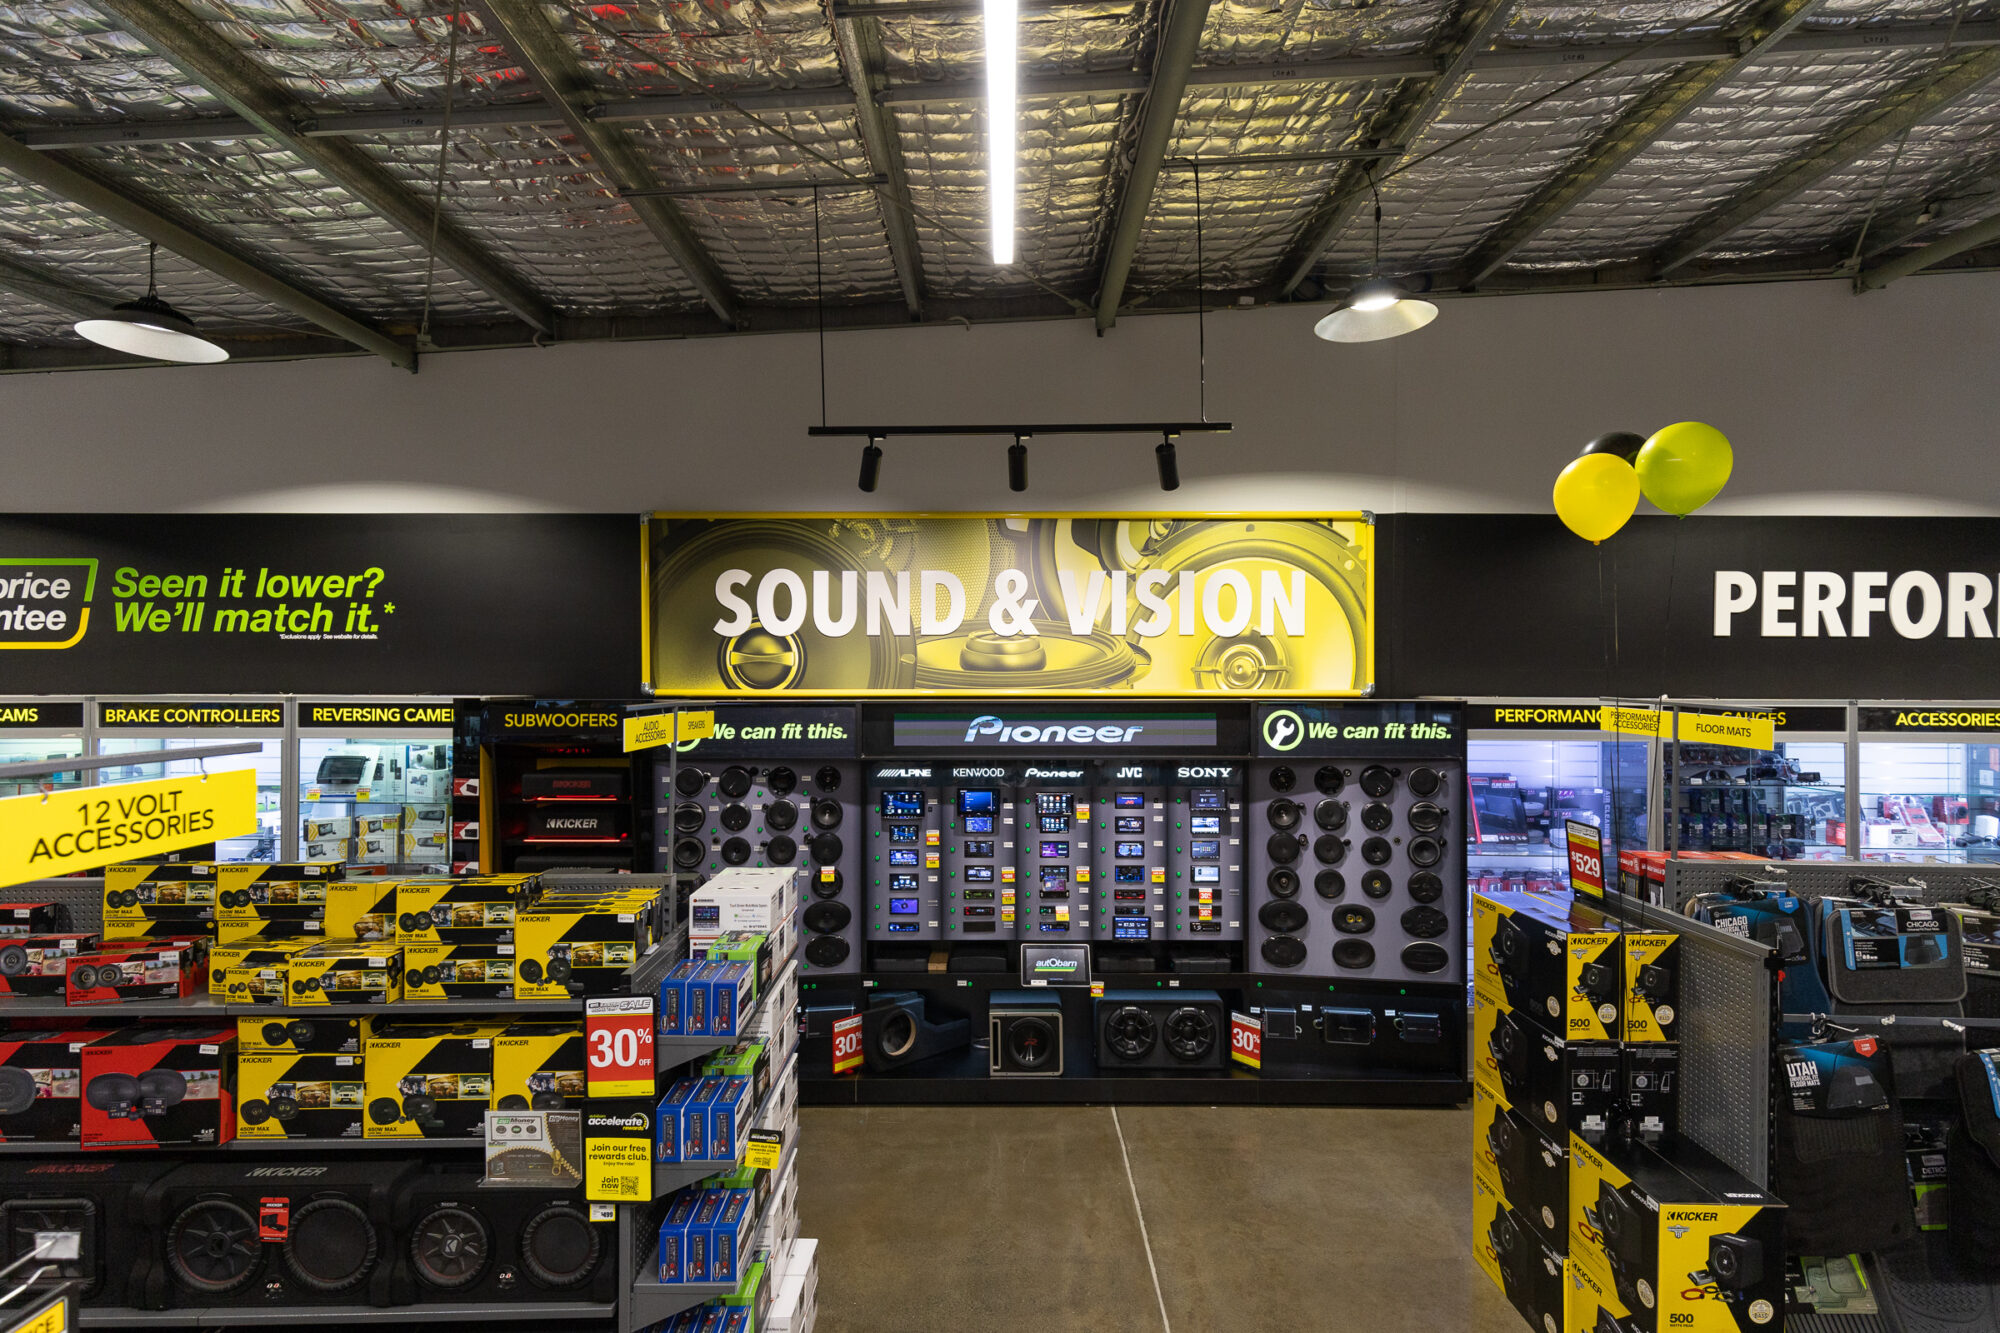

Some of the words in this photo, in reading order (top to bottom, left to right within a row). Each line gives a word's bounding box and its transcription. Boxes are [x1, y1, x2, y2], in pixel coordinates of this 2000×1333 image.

[112, 566, 208, 598] Seen
[219, 567, 244, 598] it
[255, 566, 386, 598] lower?
[712, 567, 967, 638] SOUND
[987, 567, 1041, 638] &
[1058, 568, 1307, 638] VISION
[1713, 569, 2000, 640] PERFOR
[214, 601, 333, 633] match
[0, 708, 39, 723] AMS
[105, 709, 161, 723] BRAKE
[163, 708, 281, 723] CONTROLLERS
[313, 707, 400, 723] REVERSING
[403, 708, 454, 722] CAME
[504, 713, 619, 728] SUBWOOFERS
[1610, 711, 1661, 724] PERFORMANCE
[1895, 712, 2000, 727] ACCESSORIES
[643, 720, 660, 732] AUDIO
[687, 720, 706, 730] SPEAKERS
[708, 723, 736, 740] We
[740, 726, 775, 740] can
[781, 723, 803, 740] fit
[806, 723, 849, 740] this.
[1308, 722, 1338, 739] We
[1343, 725, 1379, 739] can
[1384, 722, 1406, 739] fit
[1410, 722, 1453, 740] this.
[1612, 720, 1659, 732] ACCESSORIES
[1696, 723, 1725, 735] FLOOR
[1726, 725, 1752, 738] MATS
[634, 729, 667, 744] ACCESSORIES
[952, 767, 1005, 778] KENWOOD
[1116, 767, 1143, 778] JVC
[1177, 767, 1233, 778] SONY
[78, 801, 111, 826] 12
[117, 790, 183, 819] VOLT
[556, 818, 598, 829] KICKER
[28, 809, 215, 864] ACCESSORIES
[1571, 850, 1601, 878] $529
[1715, 915, 1748, 929] CHICAGO
[1577, 937, 1609, 945] KICKER
[1635, 939, 1667, 947] KICKER
[619, 999, 652, 1011] SALE
[1569, 1018, 1591, 1028] 500
[1627, 1020, 1648, 1029] 500
[503, 1039, 529, 1047] KICKER
[589, 1027, 653, 1069] 30%
[1785, 1060, 1818, 1078] UTAH
[588, 1116, 643, 1127] accelerate
[591, 1144, 611, 1152] Join
[588, 1153, 626, 1161] rewards
[627, 1153, 649, 1161] club.
[1577, 1144, 1604, 1171] KICKER
[1675, 1211, 1719, 1222] KICKER
[1577, 1265, 1603, 1297] KICKER
[1669, 1313, 1694, 1323] 500
